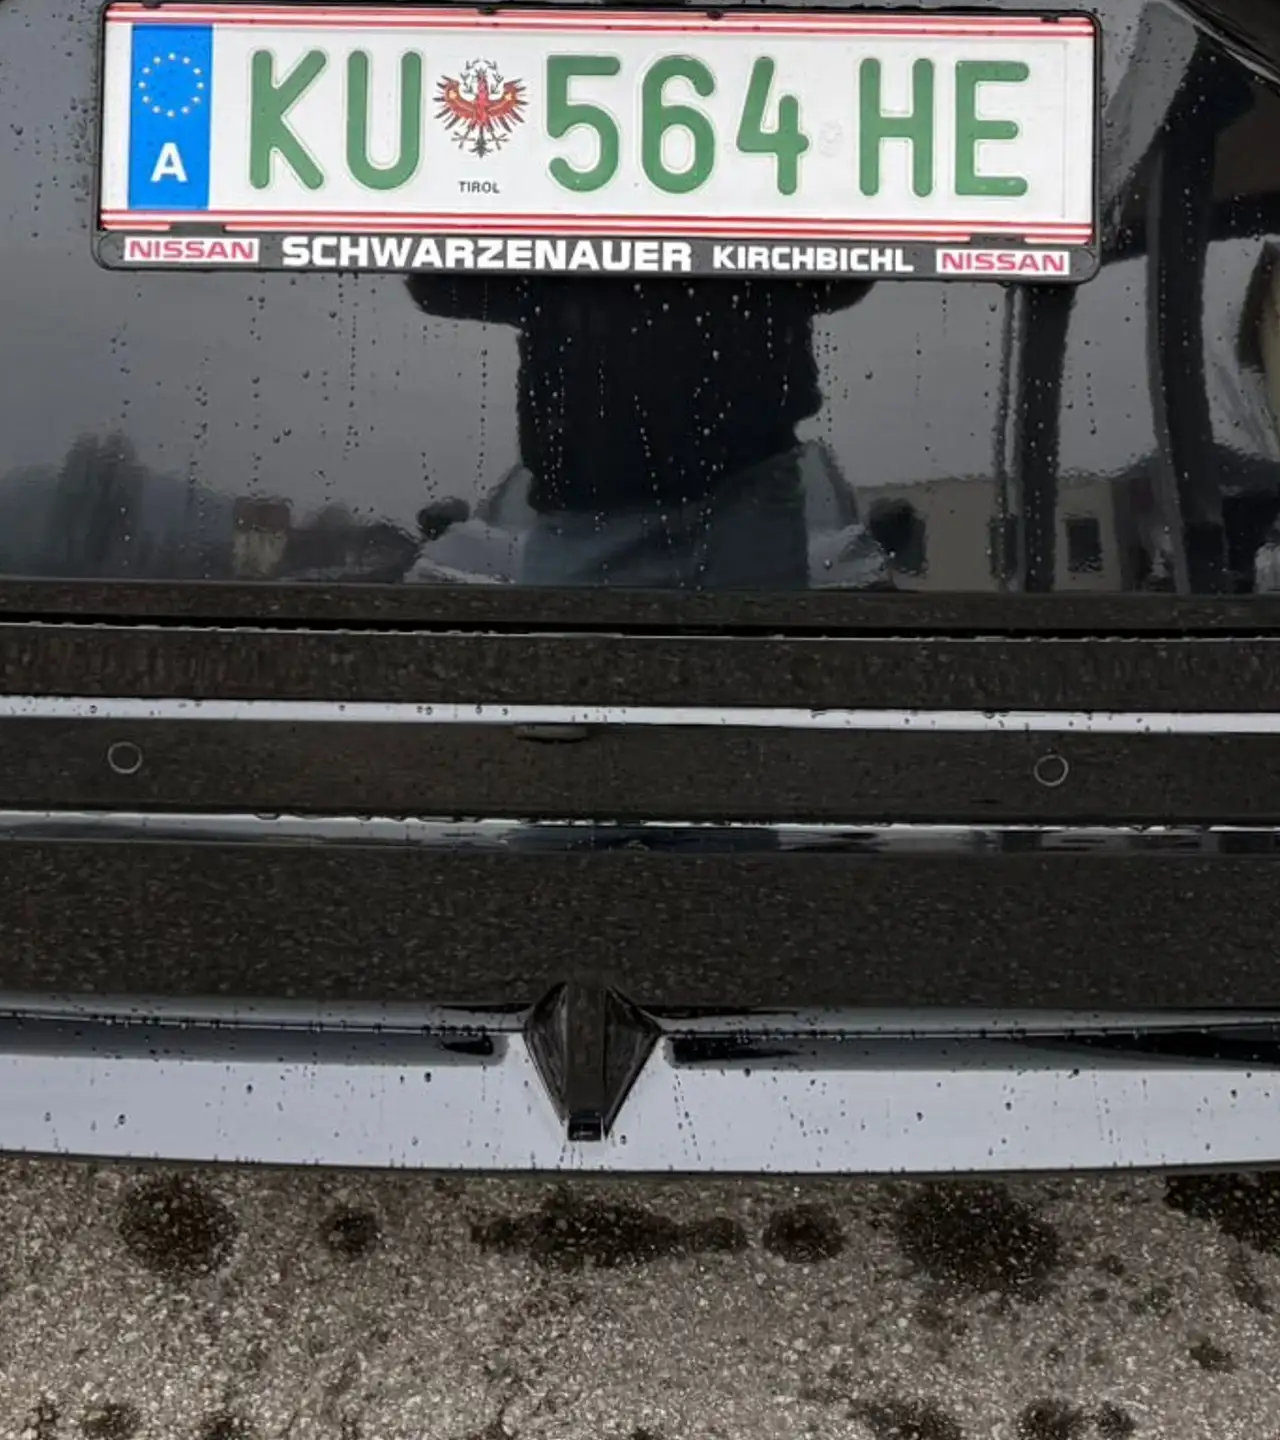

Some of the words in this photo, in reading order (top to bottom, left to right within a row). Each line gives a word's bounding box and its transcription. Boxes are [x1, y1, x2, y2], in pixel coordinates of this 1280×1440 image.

[250, 48, 423, 192] KU
[546, 53, 809, 196] 564
[858, 57, 1030, 198] HE
[150, 142, 188, 182] A
[458, 180, 500, 194] TIROL
[129, 240, 254, 260] NISSAN
[281, 235, 692, 273] SCHWARZENAUER
[712, 244, 916, 273] KIRCHBICHL
[942, 253, 1067, 273] NISSAN
